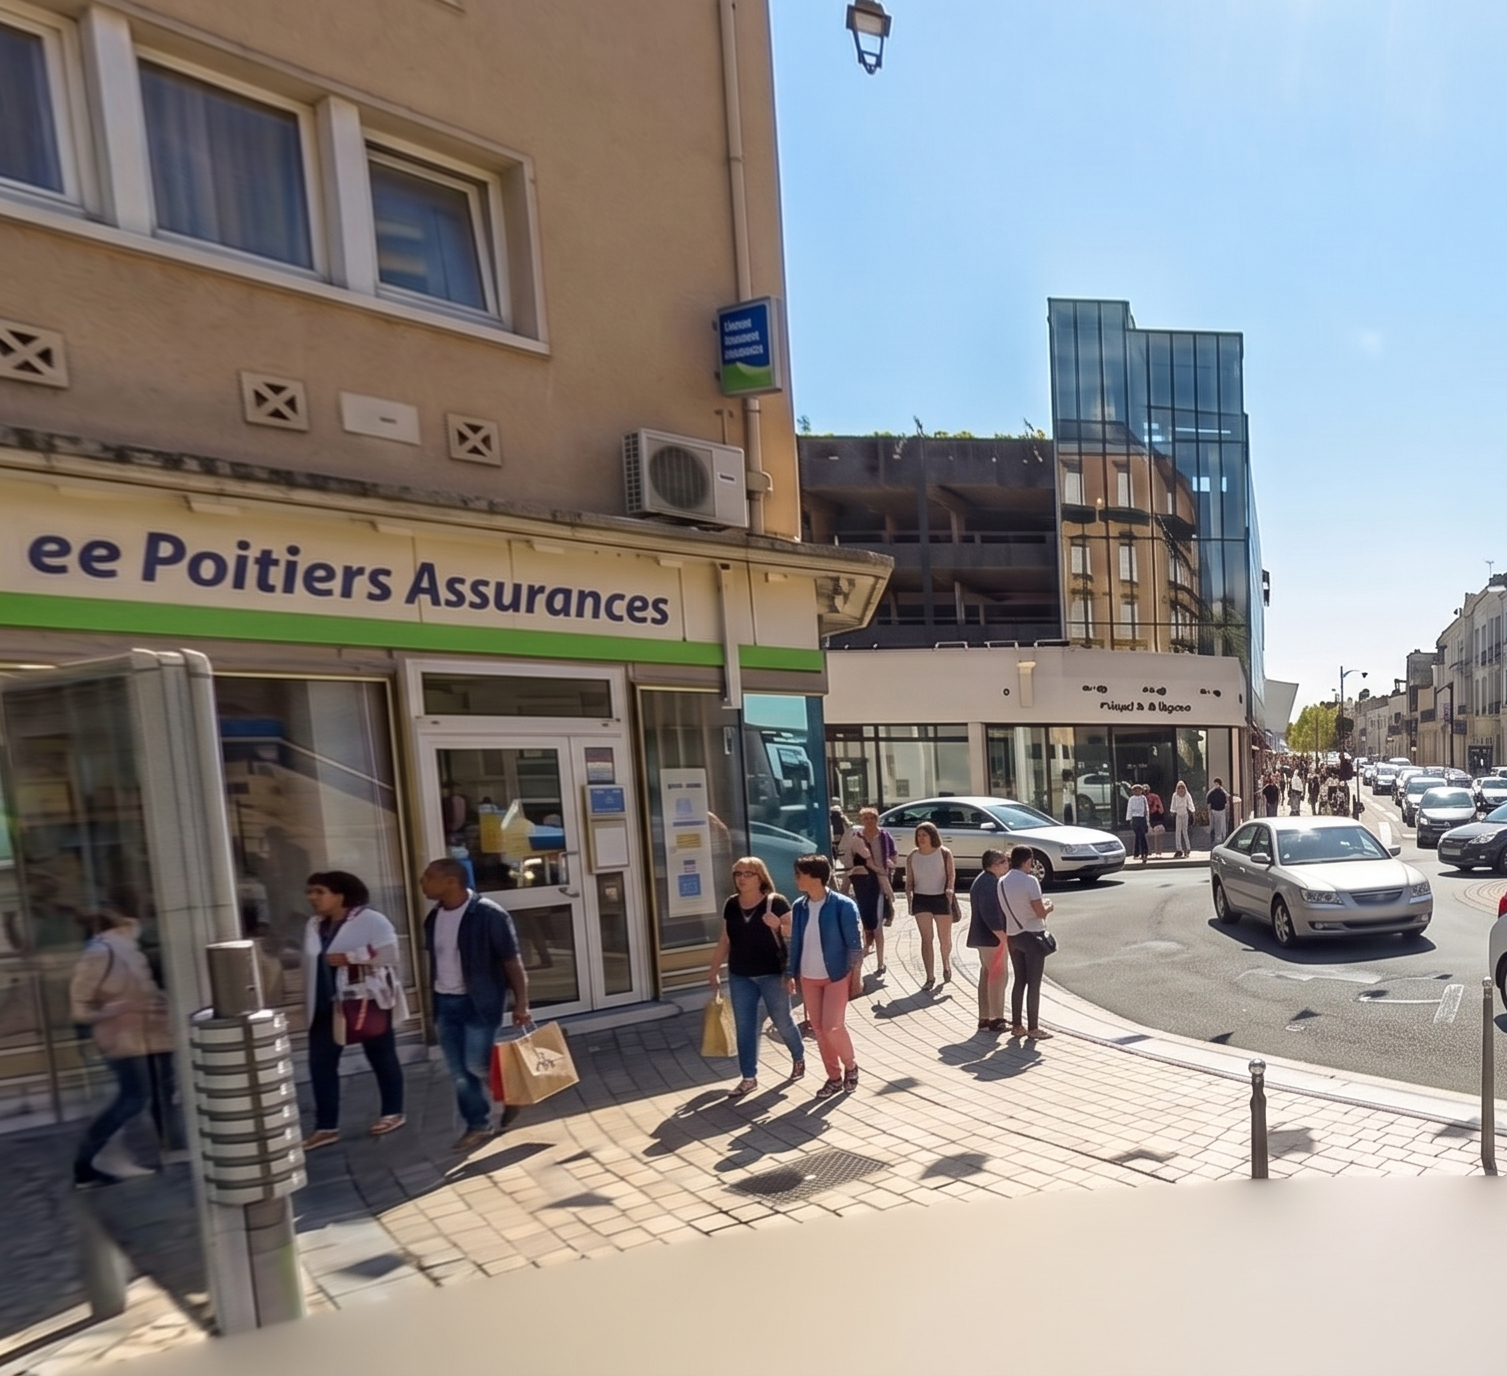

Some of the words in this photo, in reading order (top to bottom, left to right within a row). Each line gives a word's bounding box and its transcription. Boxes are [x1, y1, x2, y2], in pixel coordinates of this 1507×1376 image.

[28, 534, 121, 579] ee
[142, 532, 393, 603] Poitiers
[405, 562, 669, 626] Assurances
